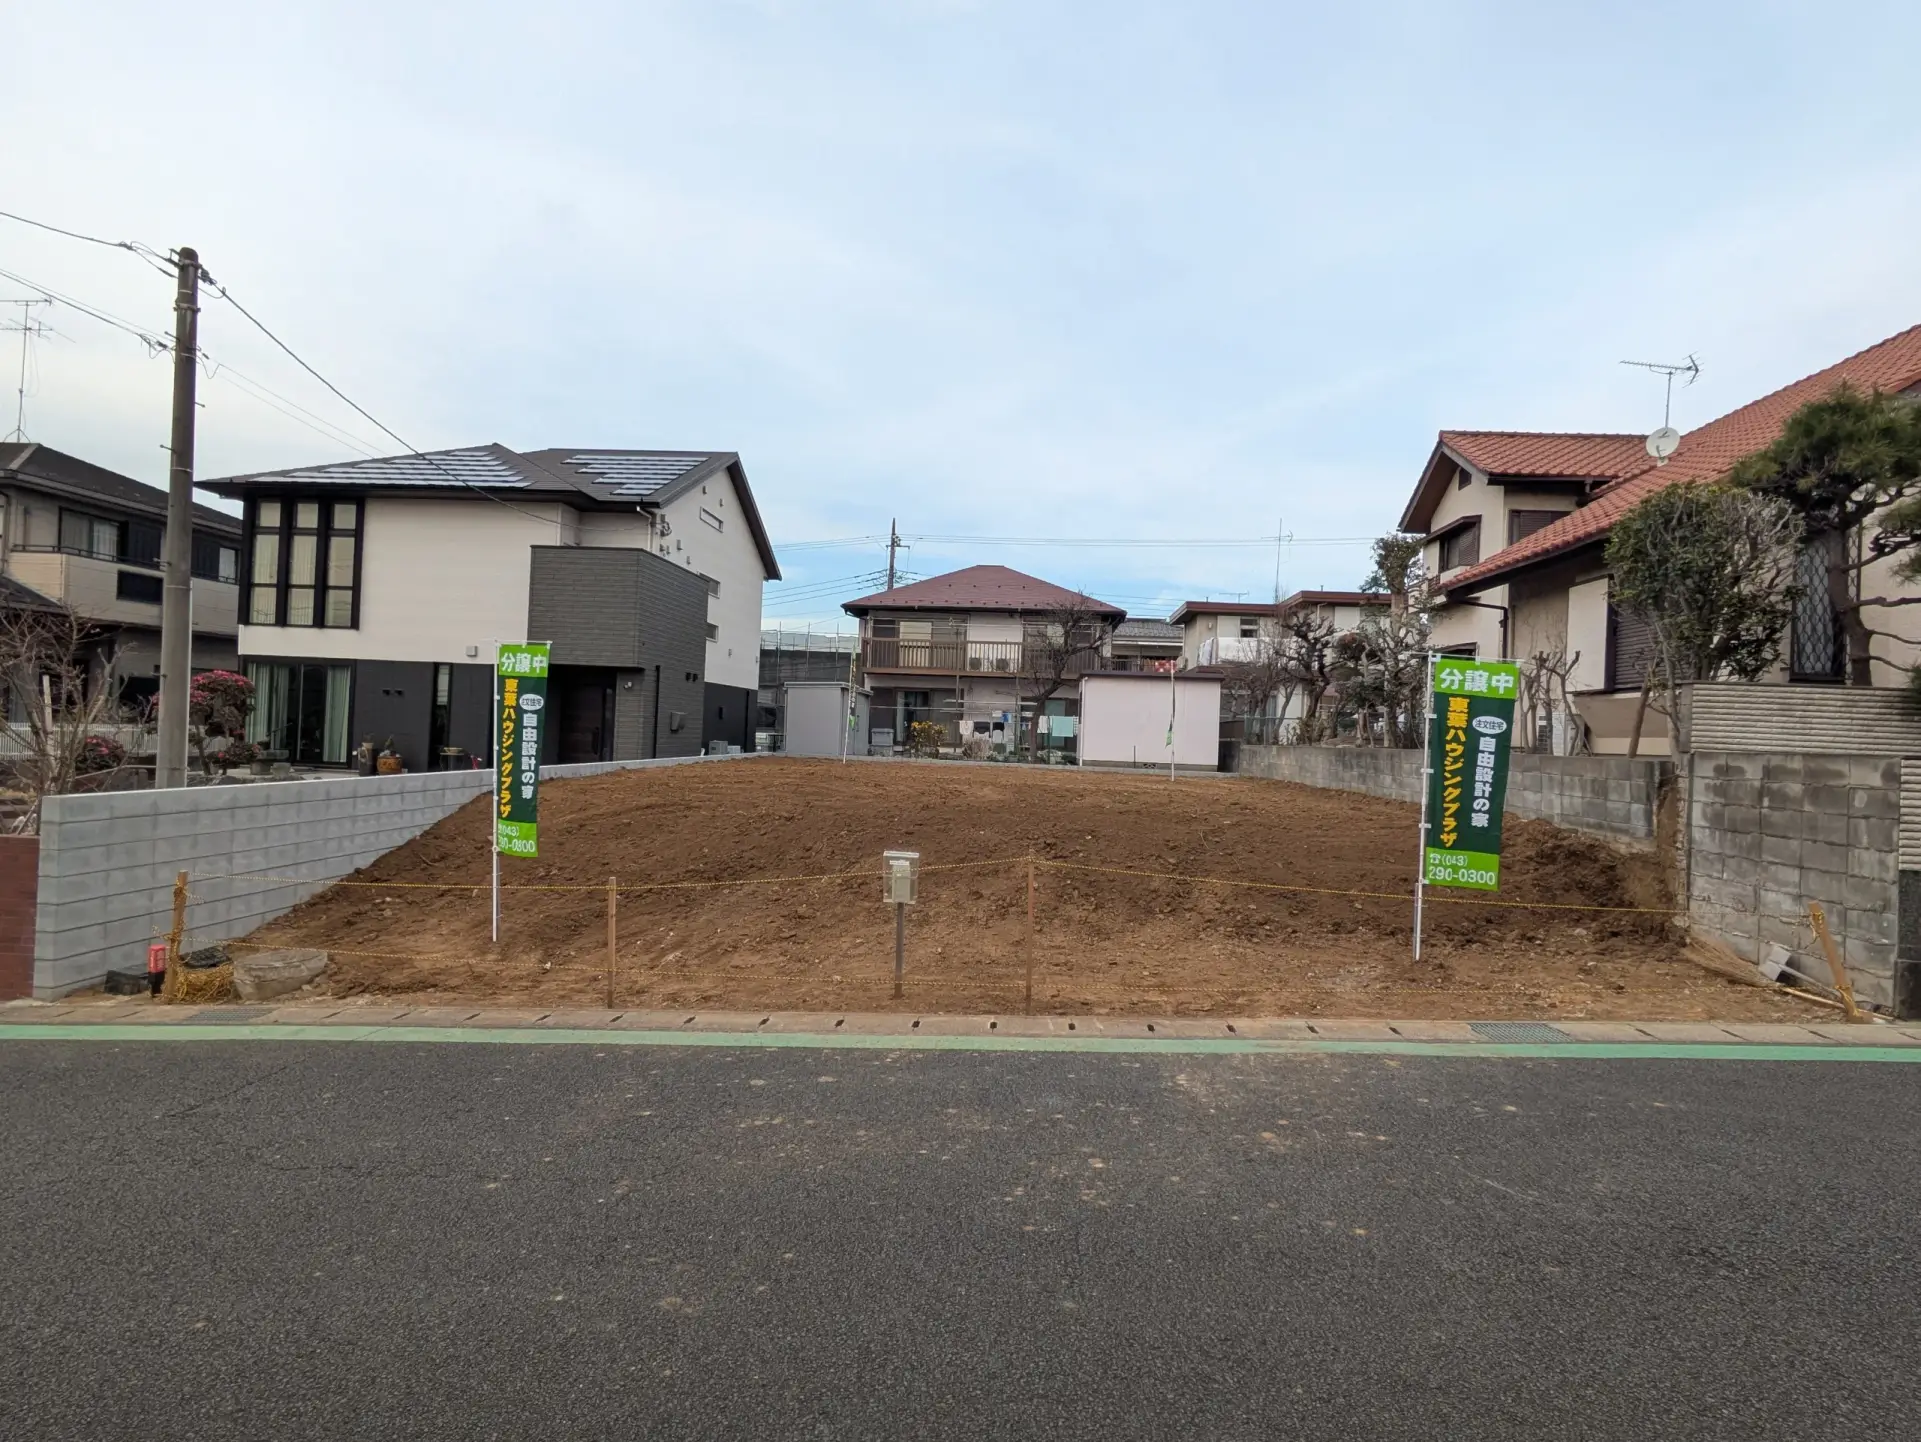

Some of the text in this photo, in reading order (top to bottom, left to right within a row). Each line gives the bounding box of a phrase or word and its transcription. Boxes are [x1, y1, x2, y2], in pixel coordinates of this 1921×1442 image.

[501, 652, 547, 674] 分譲中
[1439, 667, 1514, 694] 分譲中
[499, 678, 519, 818] 東葉ハウジングプラザ
[1475, 718, 1504, 731] 注文住宅
[521, 712, 538, 799] 自由設計の家
[1440, 697, 1470, 848] 東葉ハウジングプラザ
[1471, 736, 1497, 828] 自由設計の家
[1429, 866, 1496, 886] 290-0300
